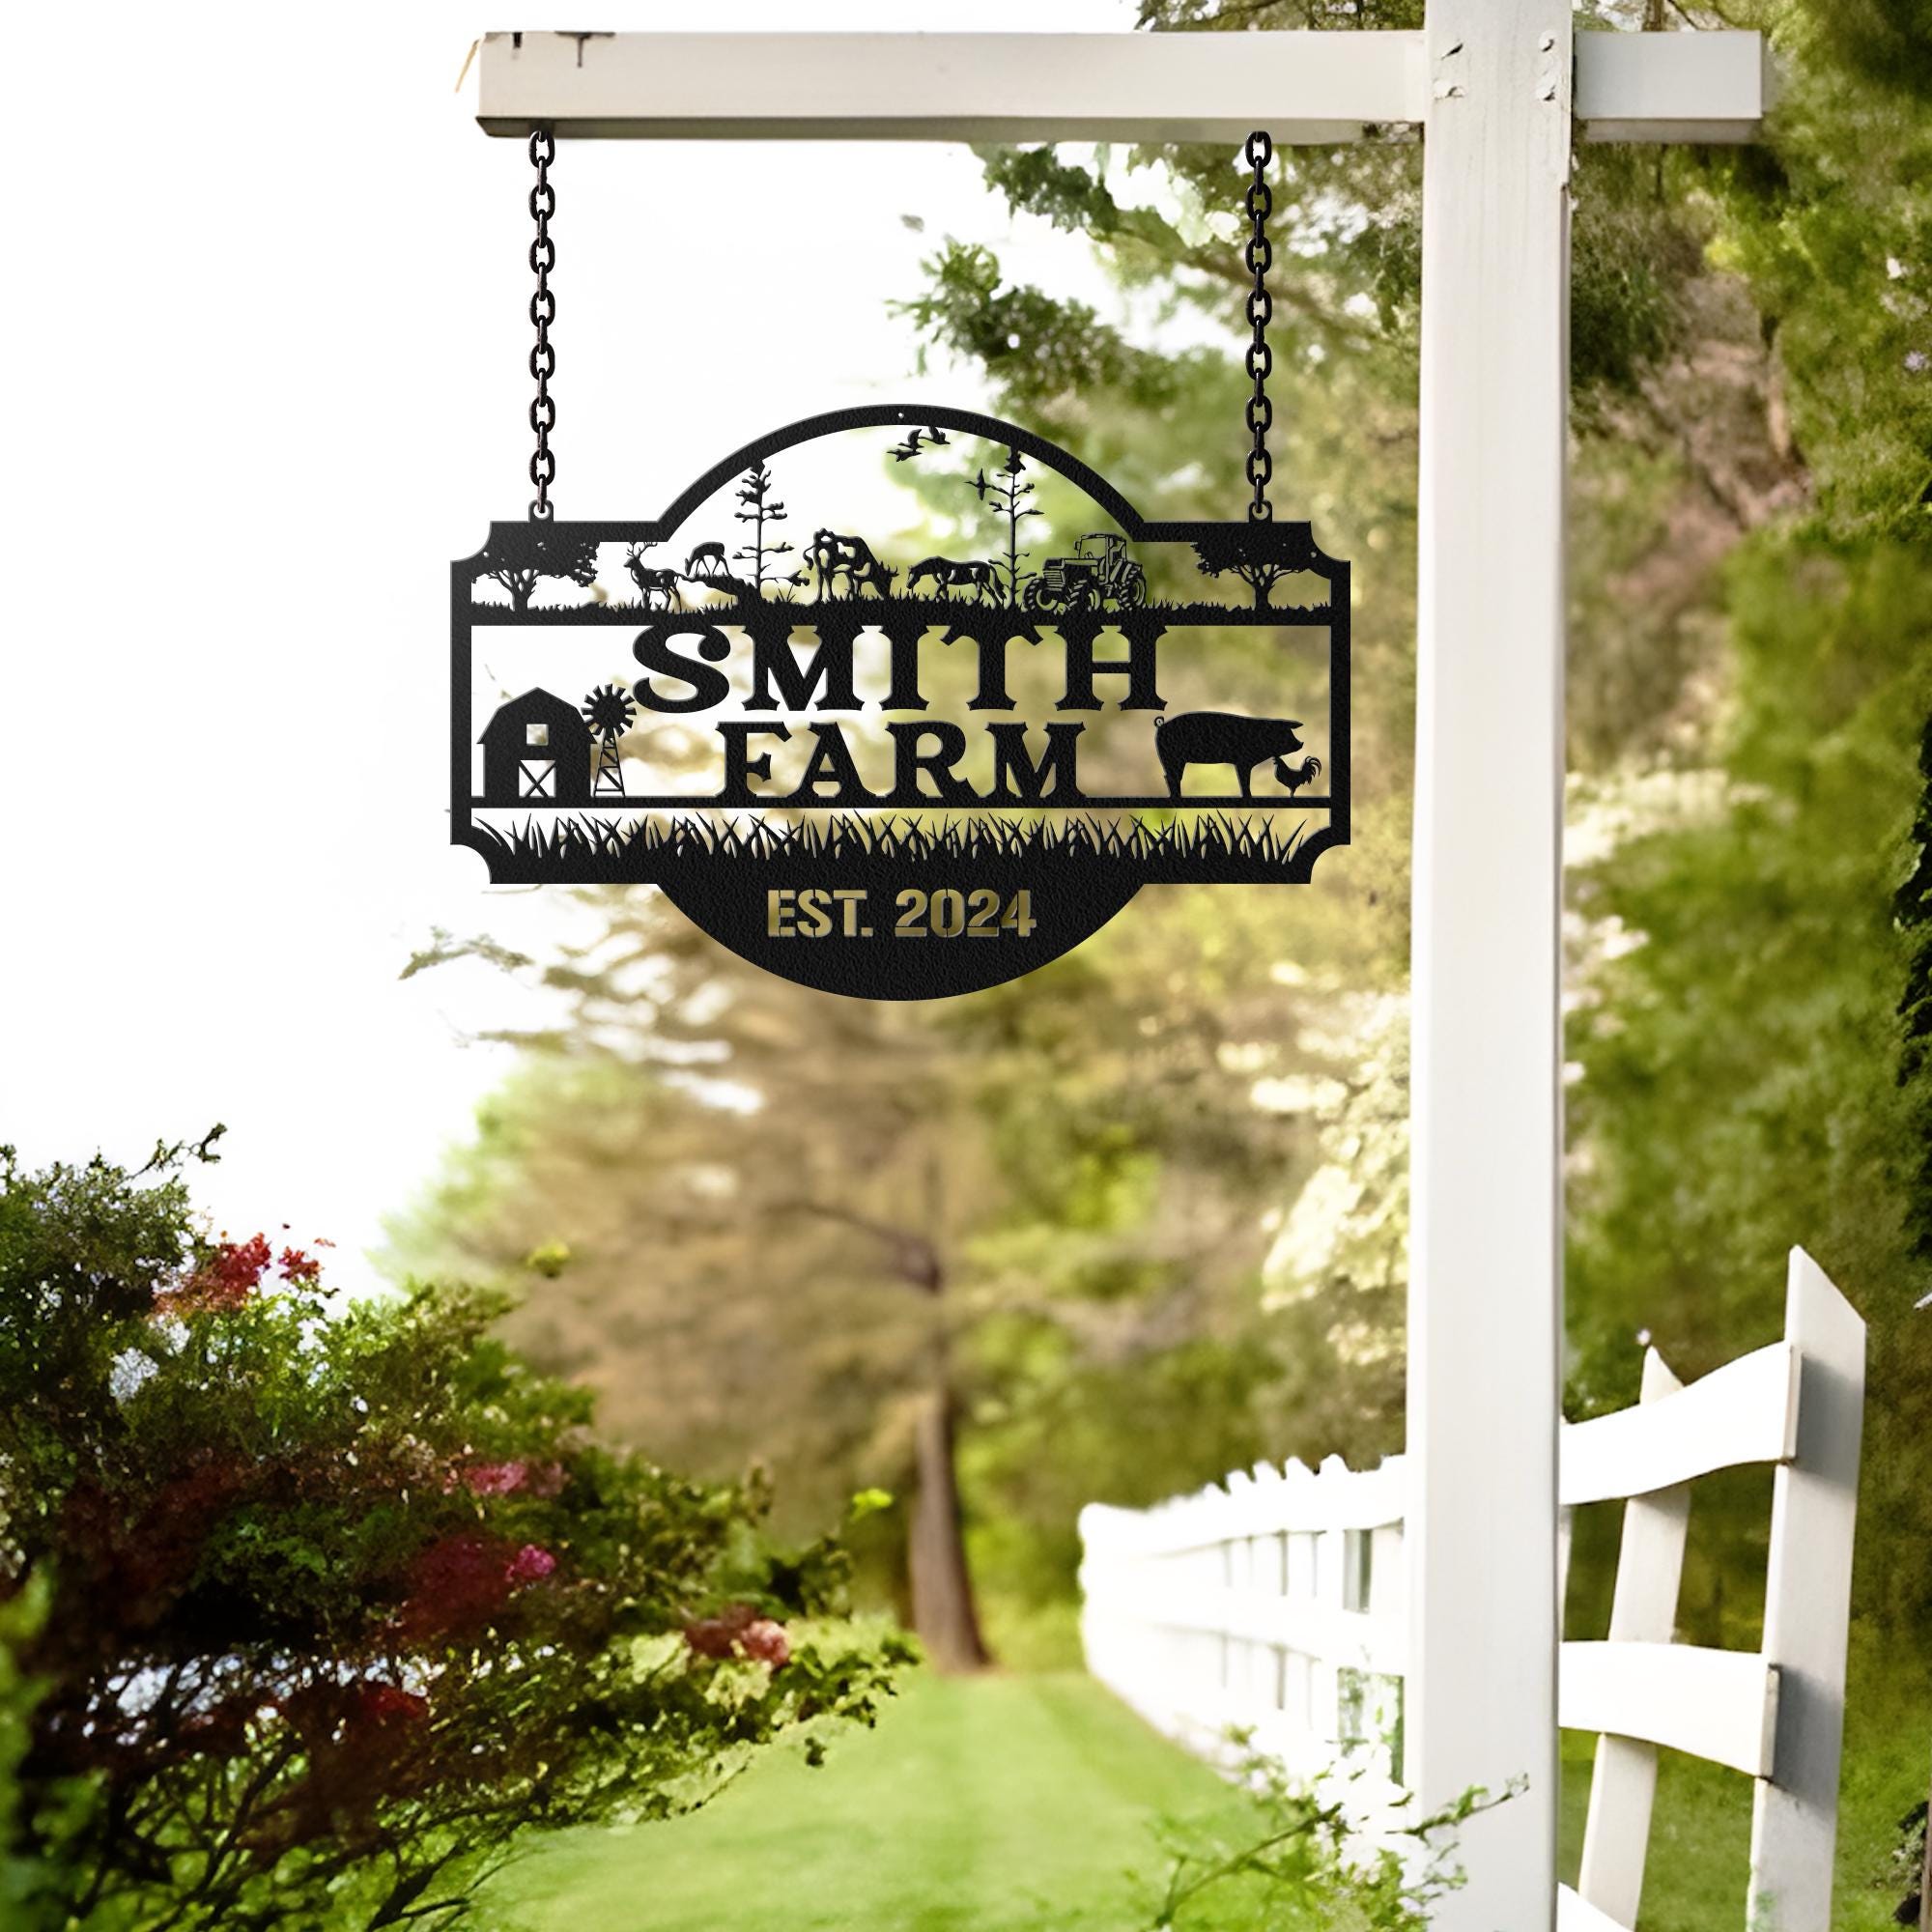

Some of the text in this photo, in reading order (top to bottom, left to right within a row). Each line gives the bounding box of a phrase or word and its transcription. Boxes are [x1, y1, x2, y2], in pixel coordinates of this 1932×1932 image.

[632, 623, 1169, 713] SMITH
[715, 721, 1087, 801] FARM
[767, 889, 1037, 937] EST. 2024
